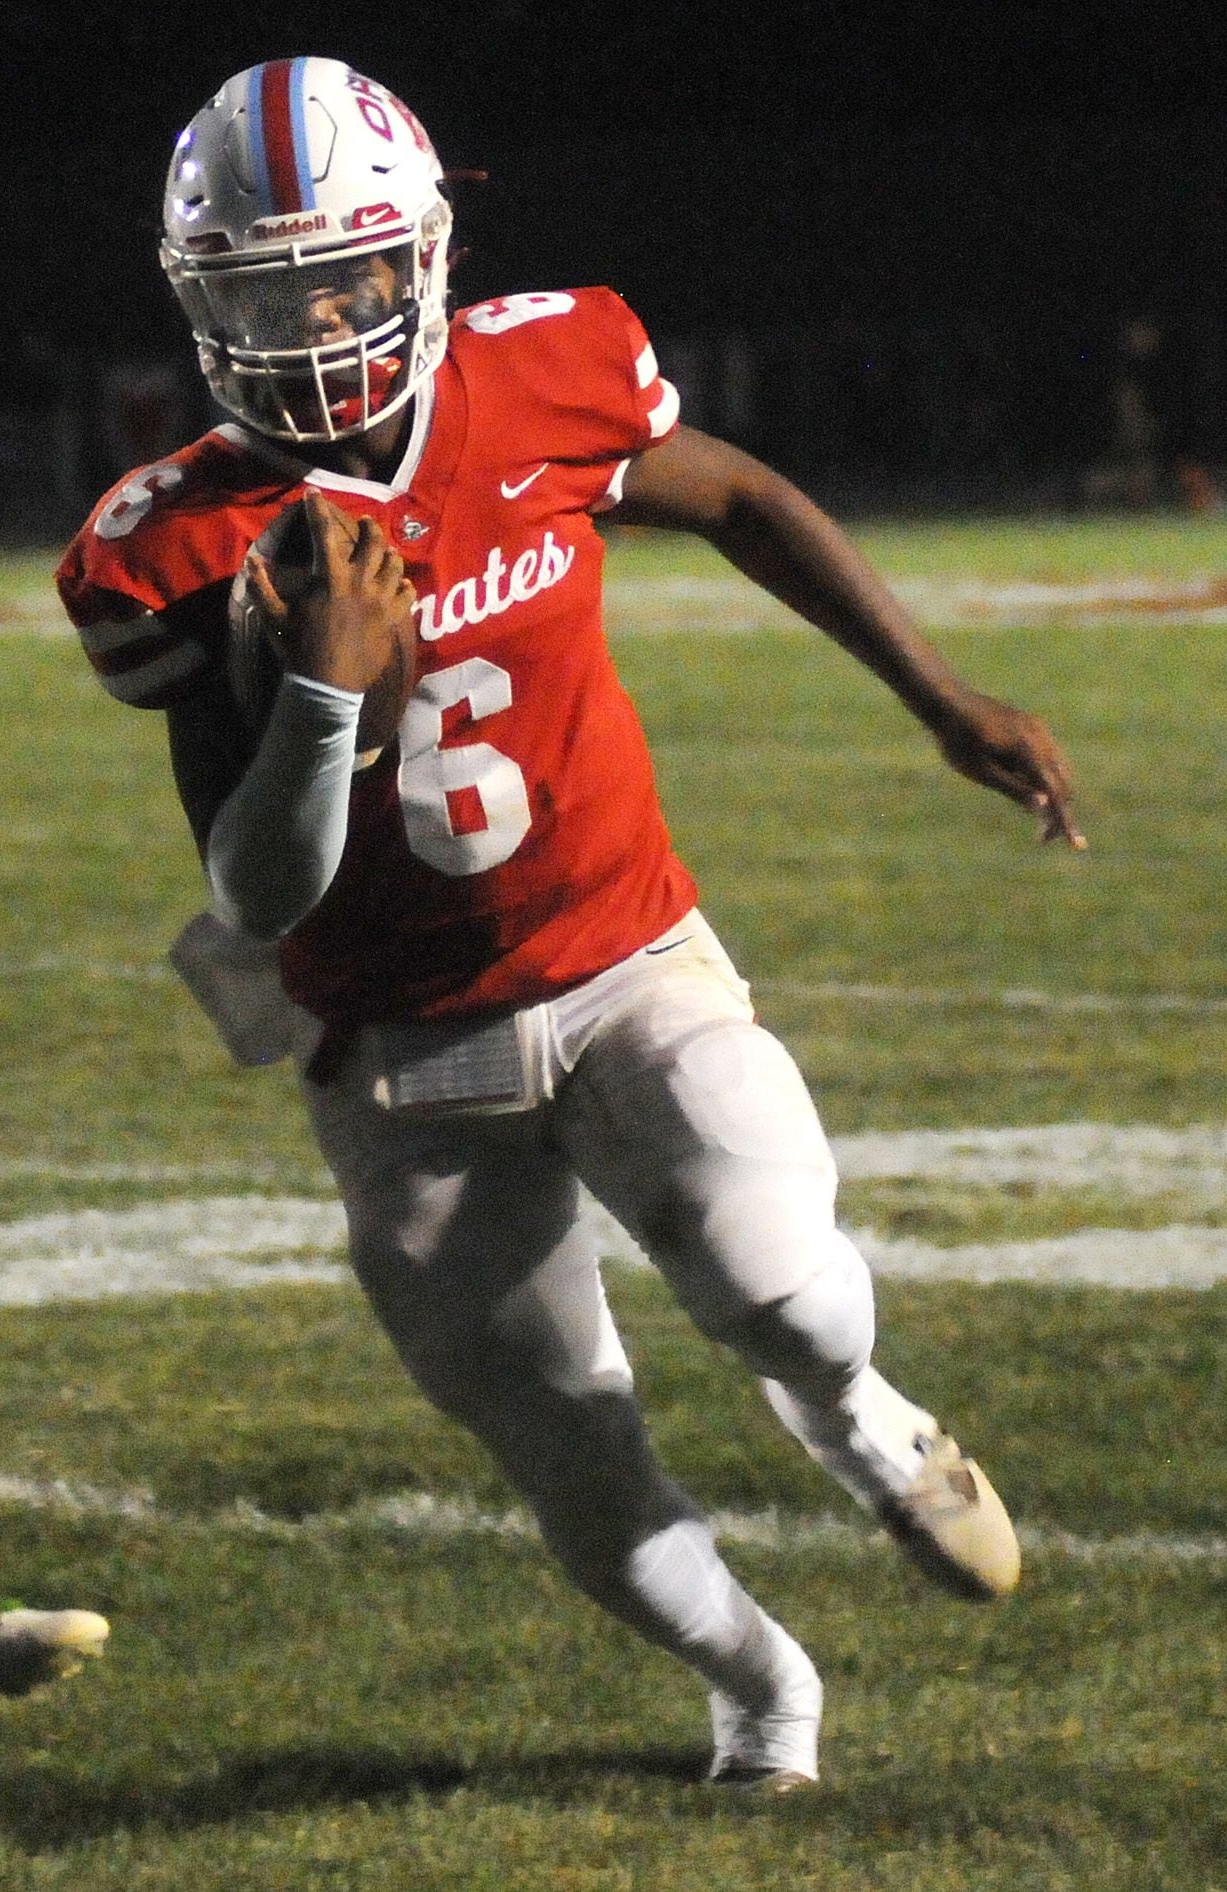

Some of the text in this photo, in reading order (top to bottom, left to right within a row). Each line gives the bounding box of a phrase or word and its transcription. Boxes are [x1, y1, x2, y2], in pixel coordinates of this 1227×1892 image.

[253, 214, 327, 239] Riddell
[467, 292, 576, 335] 6
[94, 463, 182, 540] 6
[410, 531, 575, 641] rates
[397, 656, 532, 876] 6
